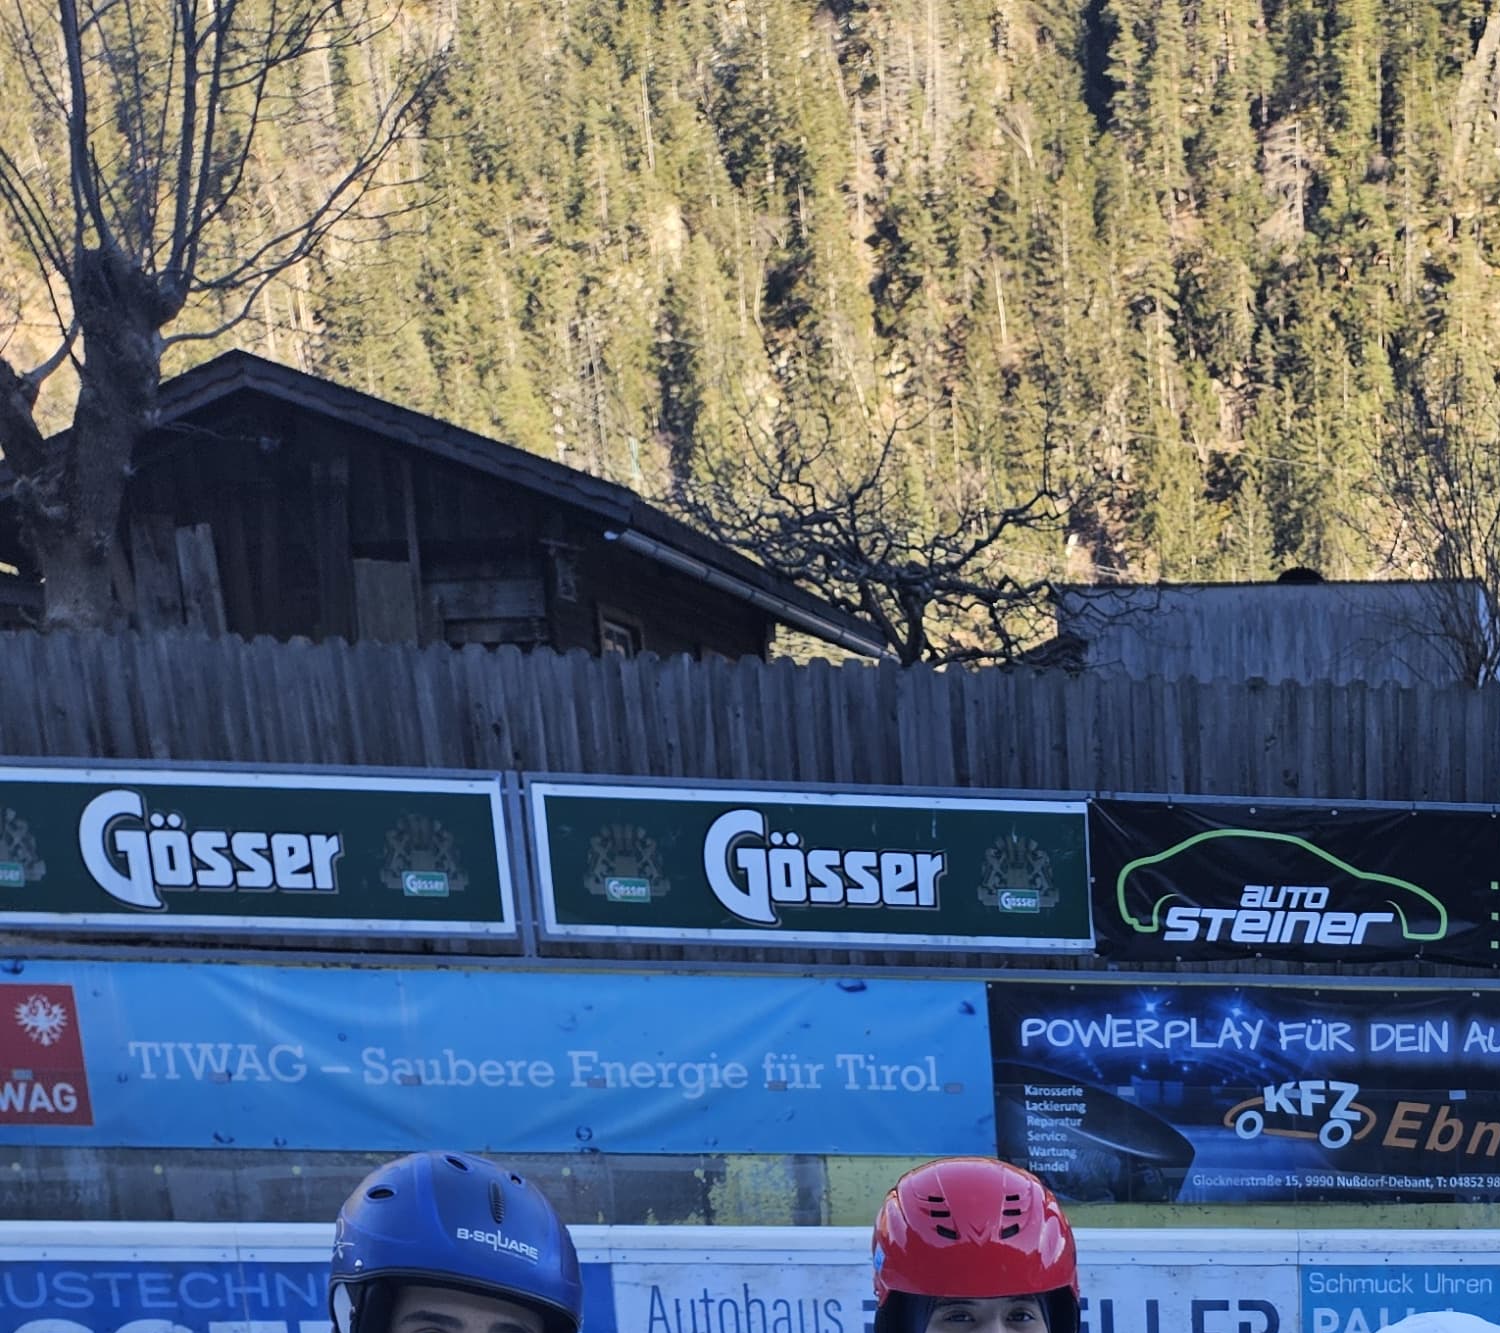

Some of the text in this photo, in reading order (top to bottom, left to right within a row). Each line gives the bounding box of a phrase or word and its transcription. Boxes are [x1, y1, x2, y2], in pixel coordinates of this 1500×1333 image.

[79, 789, 343, 909] Gösser
[704, 809, 945, 925] Gösser
[1020, 1015, 1260, 1052] POWERPLAY
[1278, 1016, 1355, 1055] FÜR
[1369, 1020, 1450, 1054] DEIN
[128, 1041, 309, 1083] TIWAG
[363, 1047, 555, 1089] Saubere
[567, 1050, 749, 1100] Energie
[762, 1053, 824, 1091] für
[836, 1054, 941, 1093] Tirol
[1024, 1084, 1083, 1097] Karosserie
[1025, 1100, 1087, 1114] Lackierung
[1263, 1080, 1363, 1122] KFZ
[1026, 1115, 1083, 1128] Reparatur
[1027, 1130, 1068, 1142] Service
[1027, 1145, 1078, 1159] Wartung
[1028, 1160, 1070, 1172] Handel
[1284, 1175, 1302, 1189] 15,
[1304, 1175, 1334, 1188] 9990
[1450, 1176, 1485, 1188] 04852
[1308, 1271, 1493, 1294] Schmuck Uhren
